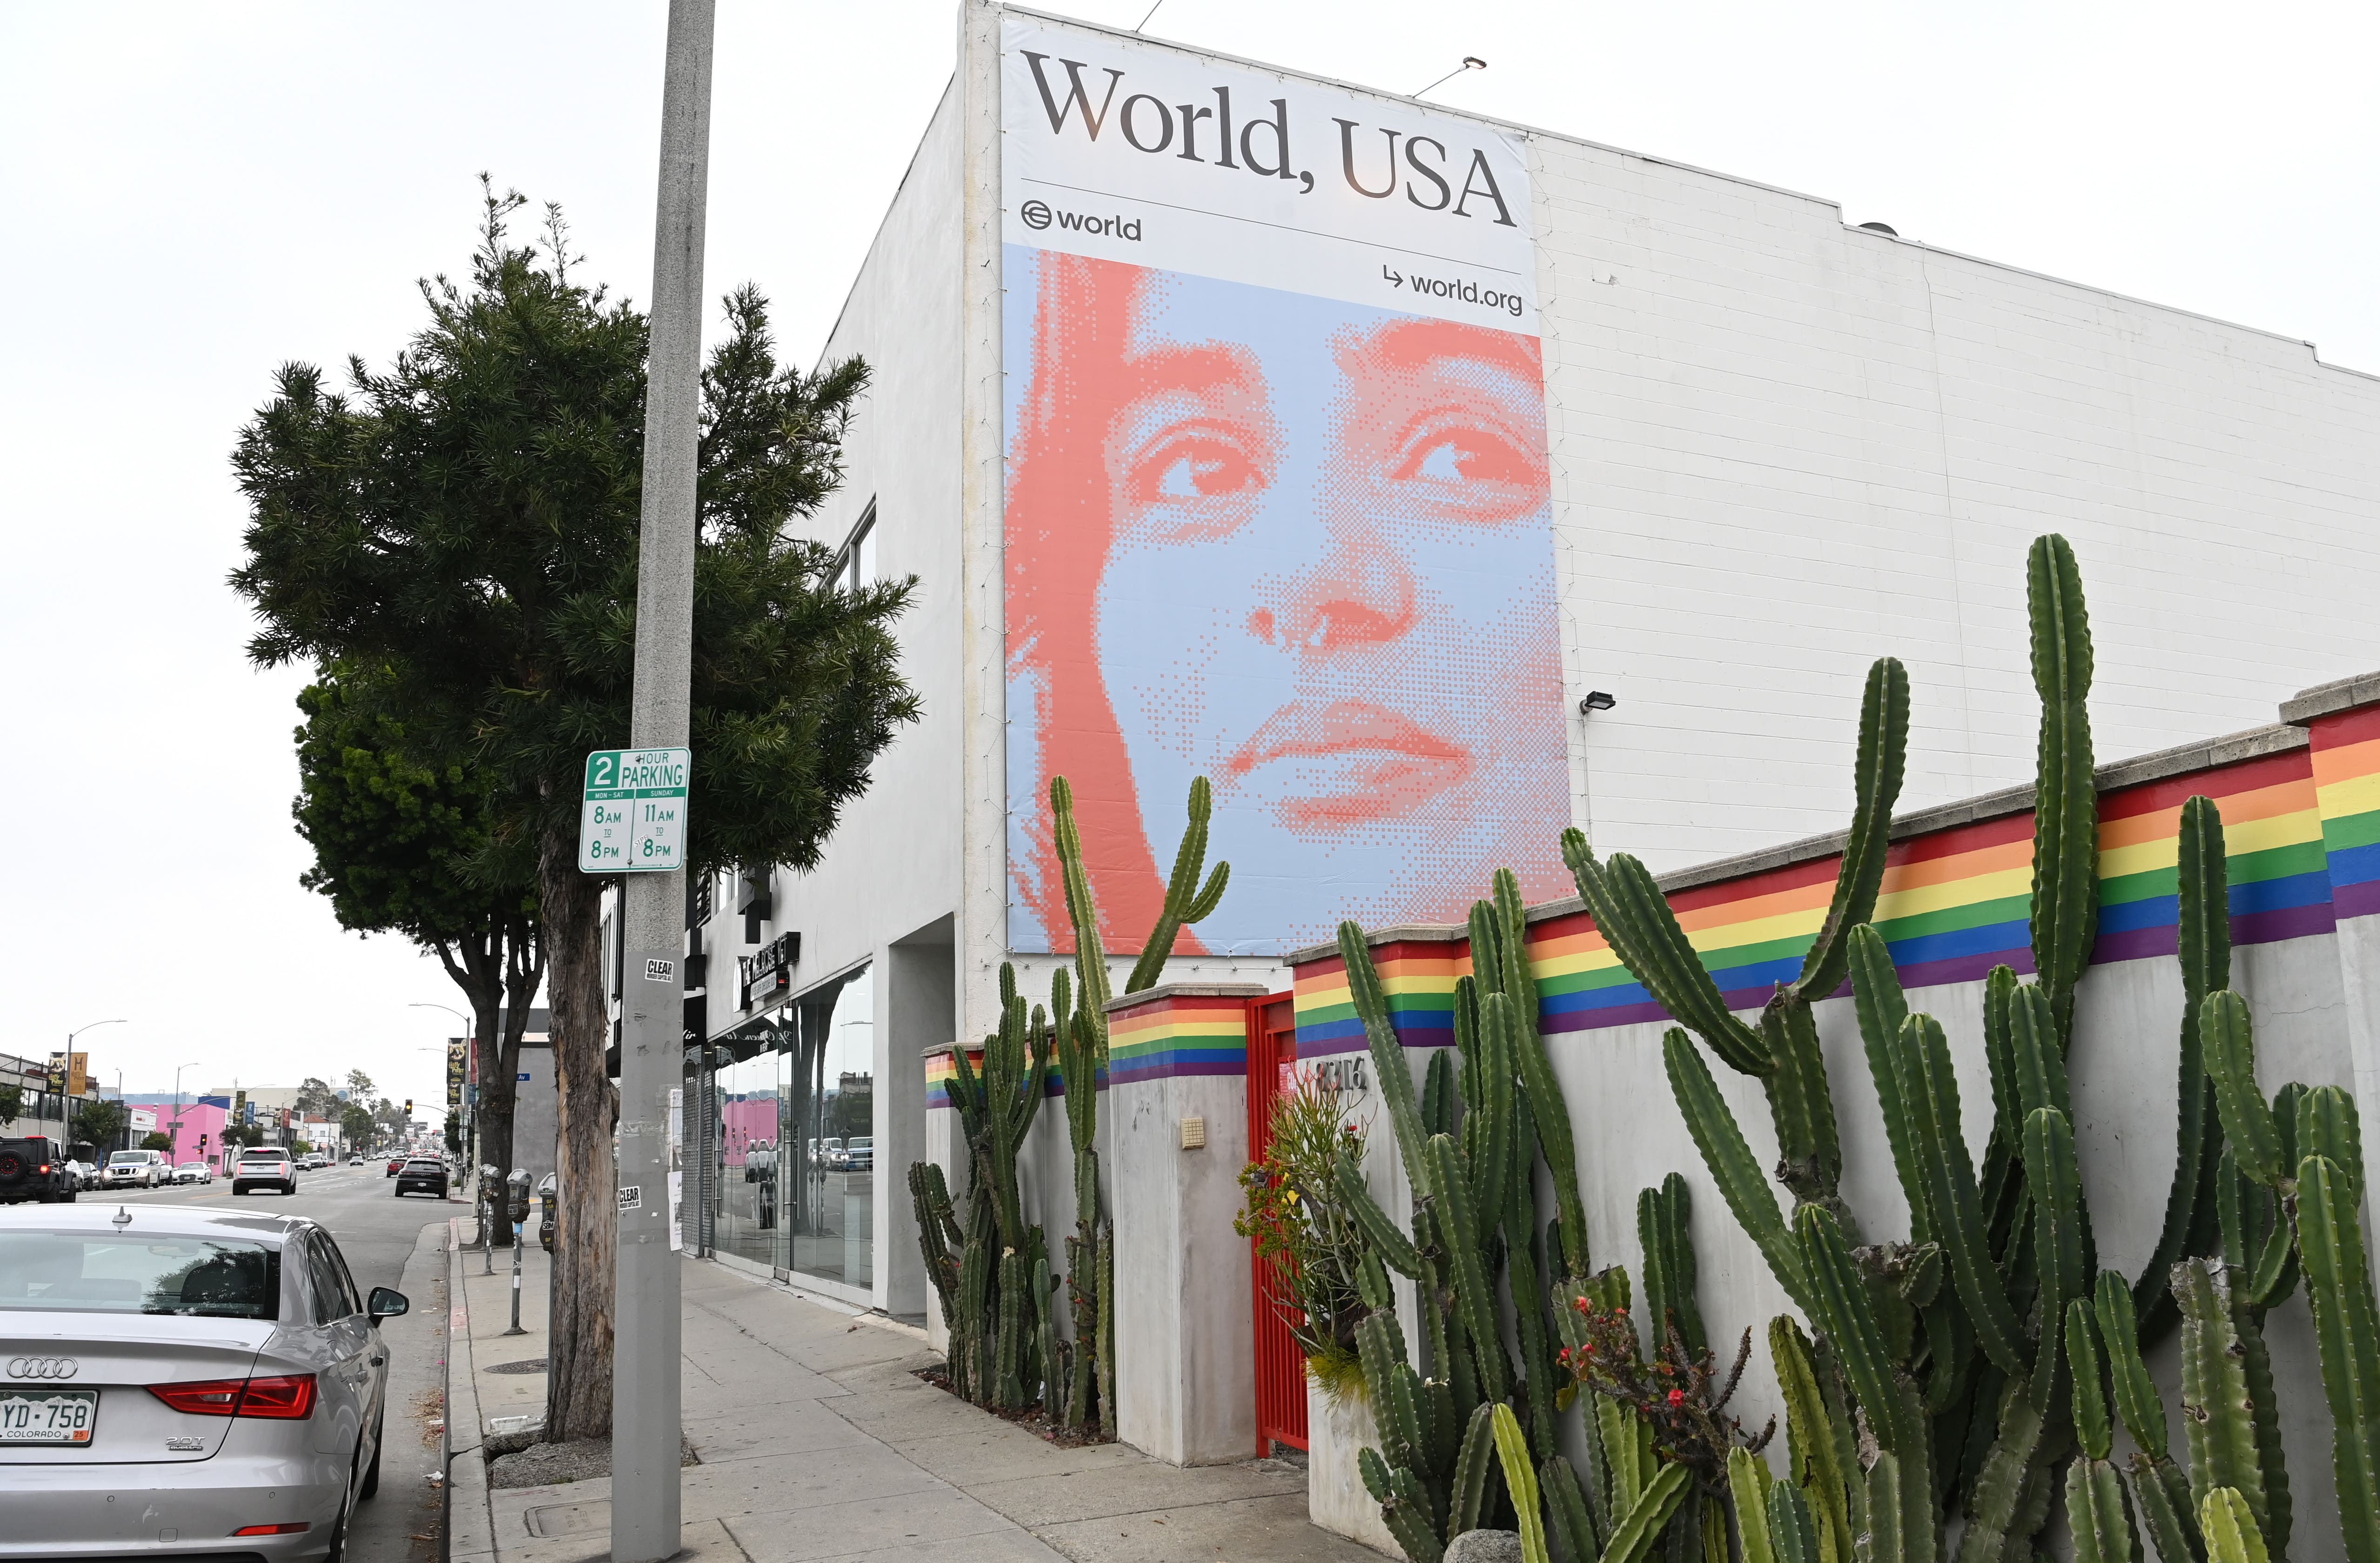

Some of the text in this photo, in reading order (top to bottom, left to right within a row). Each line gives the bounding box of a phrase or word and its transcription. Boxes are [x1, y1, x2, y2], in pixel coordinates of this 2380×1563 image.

[1020, 49, 1518, 228] World, USA
[1056, 210, 1141, 242] world
[1410, 275, 1522, 317] world.org
[594, 757, 612, 785] 2
[639, 752, 669, 765] HOUR
[621, 764, 683, 788] PARKING
[647, 960, 673, 976] CLEAR
[752, 940, 775, 982] MELROSE
[777, 932, 787, 965] VET
[620, 1187, 639, 1203] CLEAR
